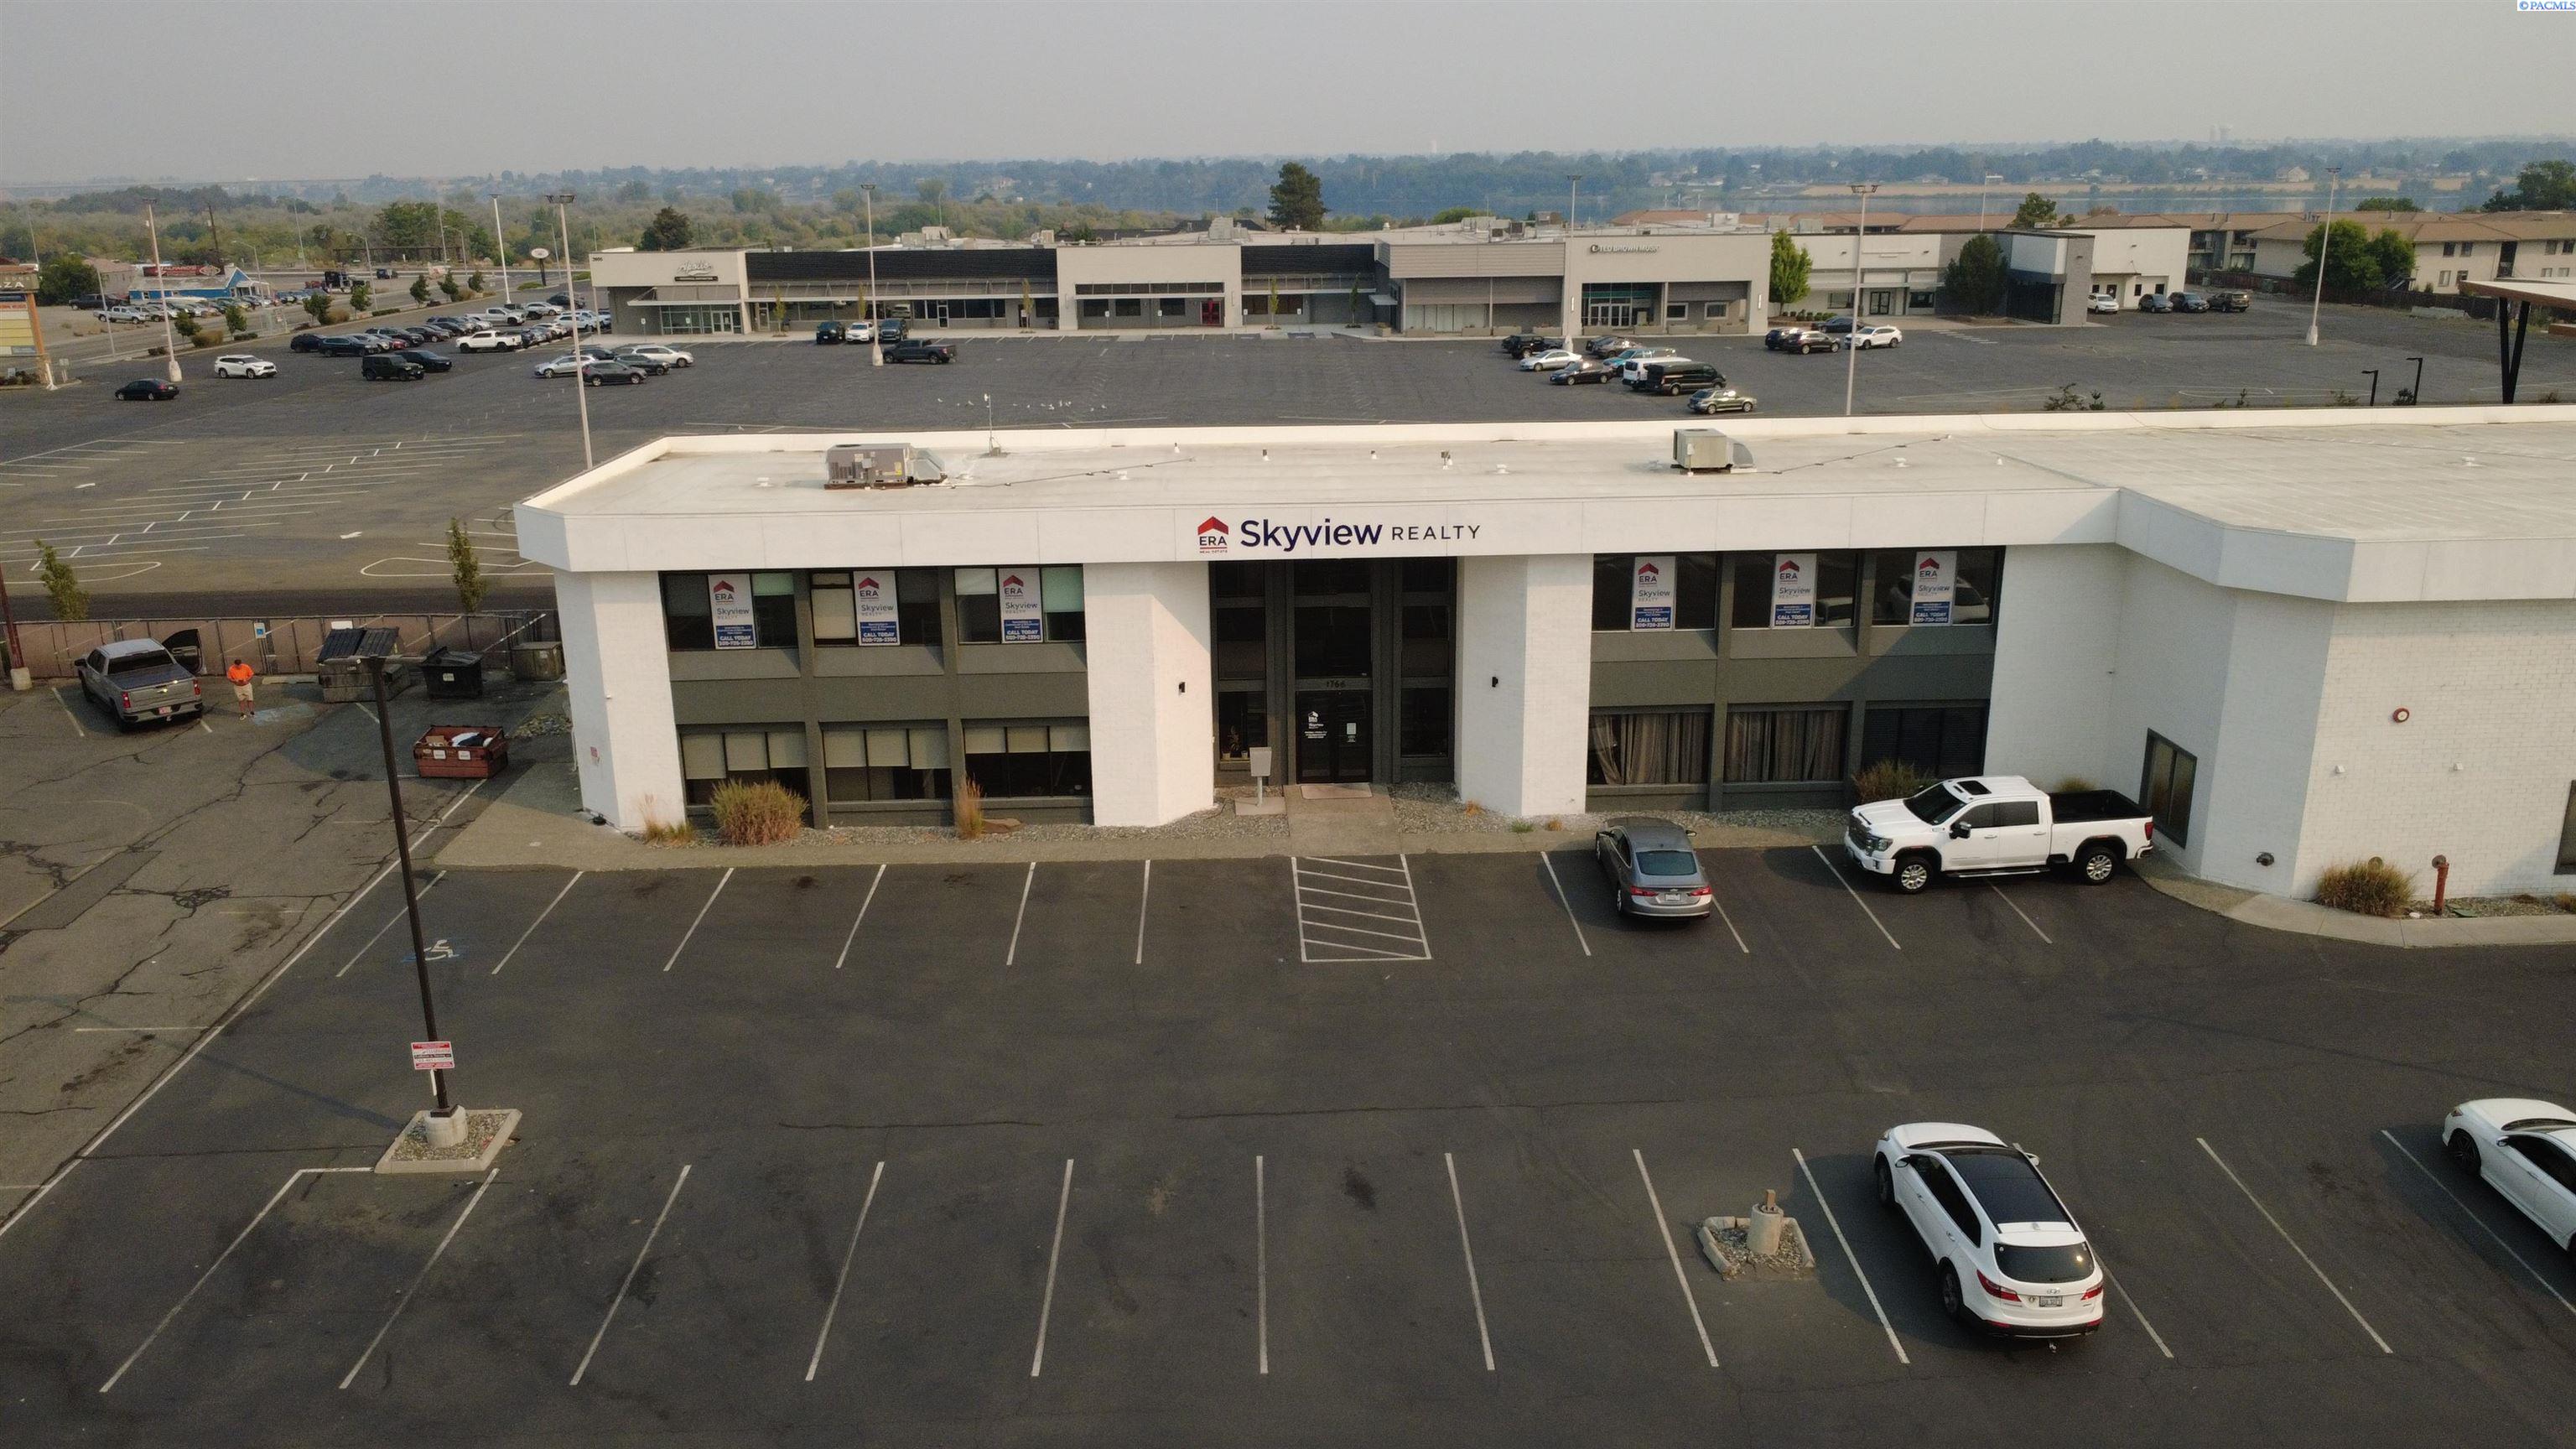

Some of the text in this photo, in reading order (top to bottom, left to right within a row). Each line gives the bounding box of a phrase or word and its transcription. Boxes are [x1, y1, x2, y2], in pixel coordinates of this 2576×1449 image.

[1240, 518, 1481, 552] Skyview REALTY
[1199, 536, 1228, 546] ERA
[1639, 589, 1670, 598] Skyview
[717, 608, 750, 616] Skyview
[861, 604, 894, 612] Skyview
